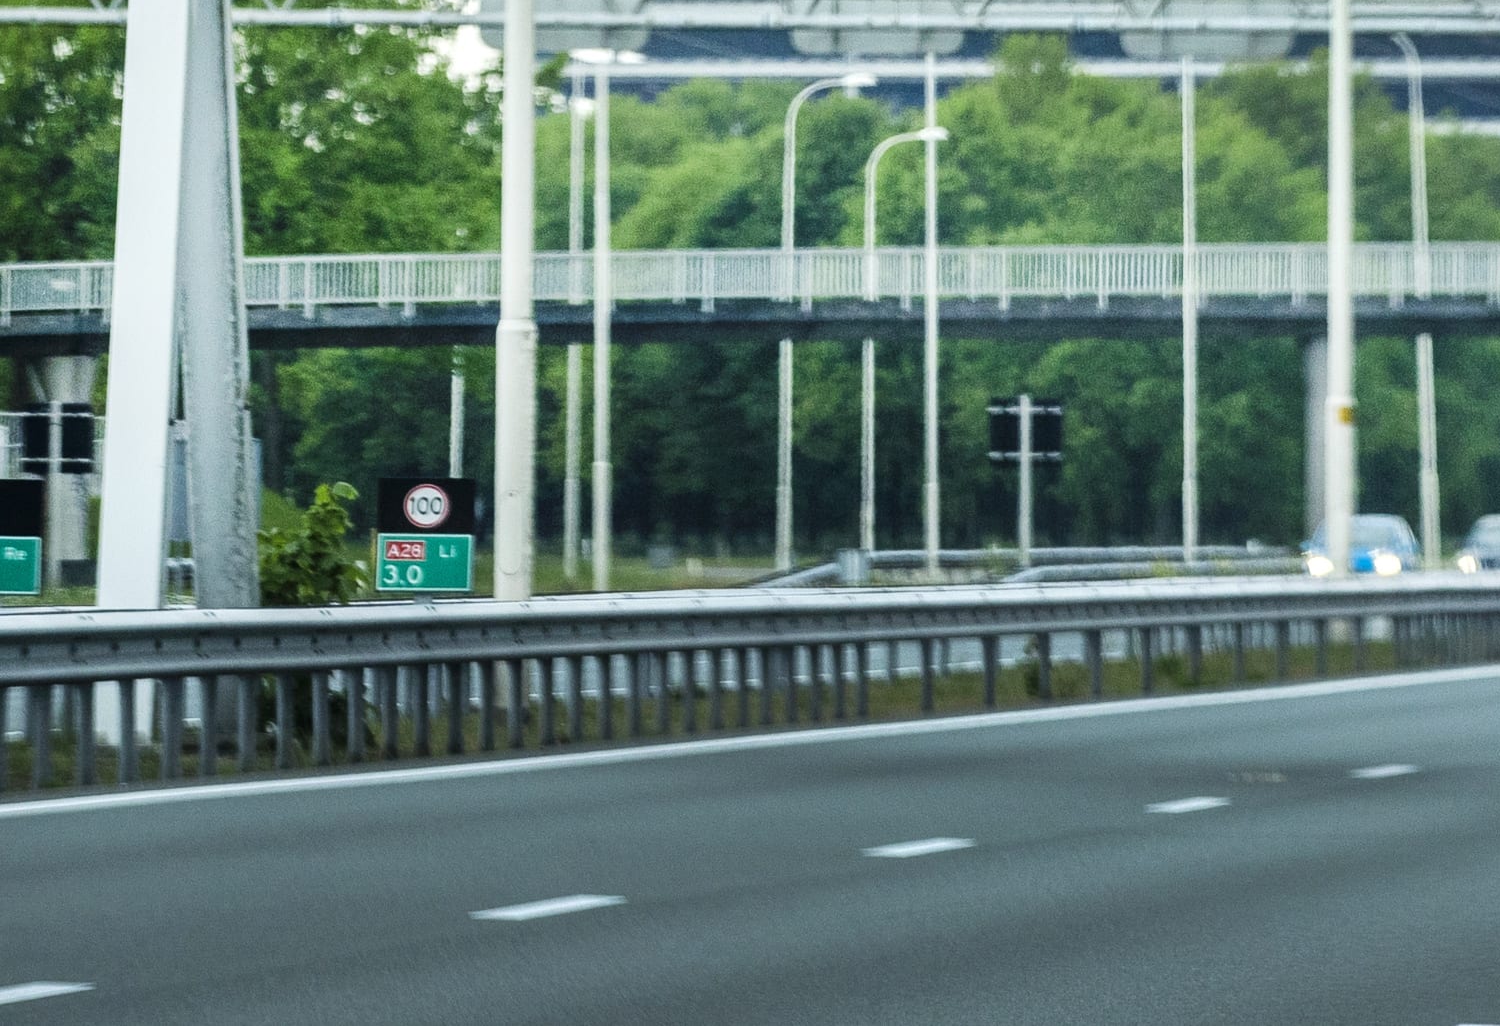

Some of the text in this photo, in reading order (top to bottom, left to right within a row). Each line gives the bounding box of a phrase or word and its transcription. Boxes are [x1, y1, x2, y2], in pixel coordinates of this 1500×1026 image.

[408, 496, 442, 515] 100
[386, 543, 422, 558] A28
[383, 564, 422, 586] 3.0
